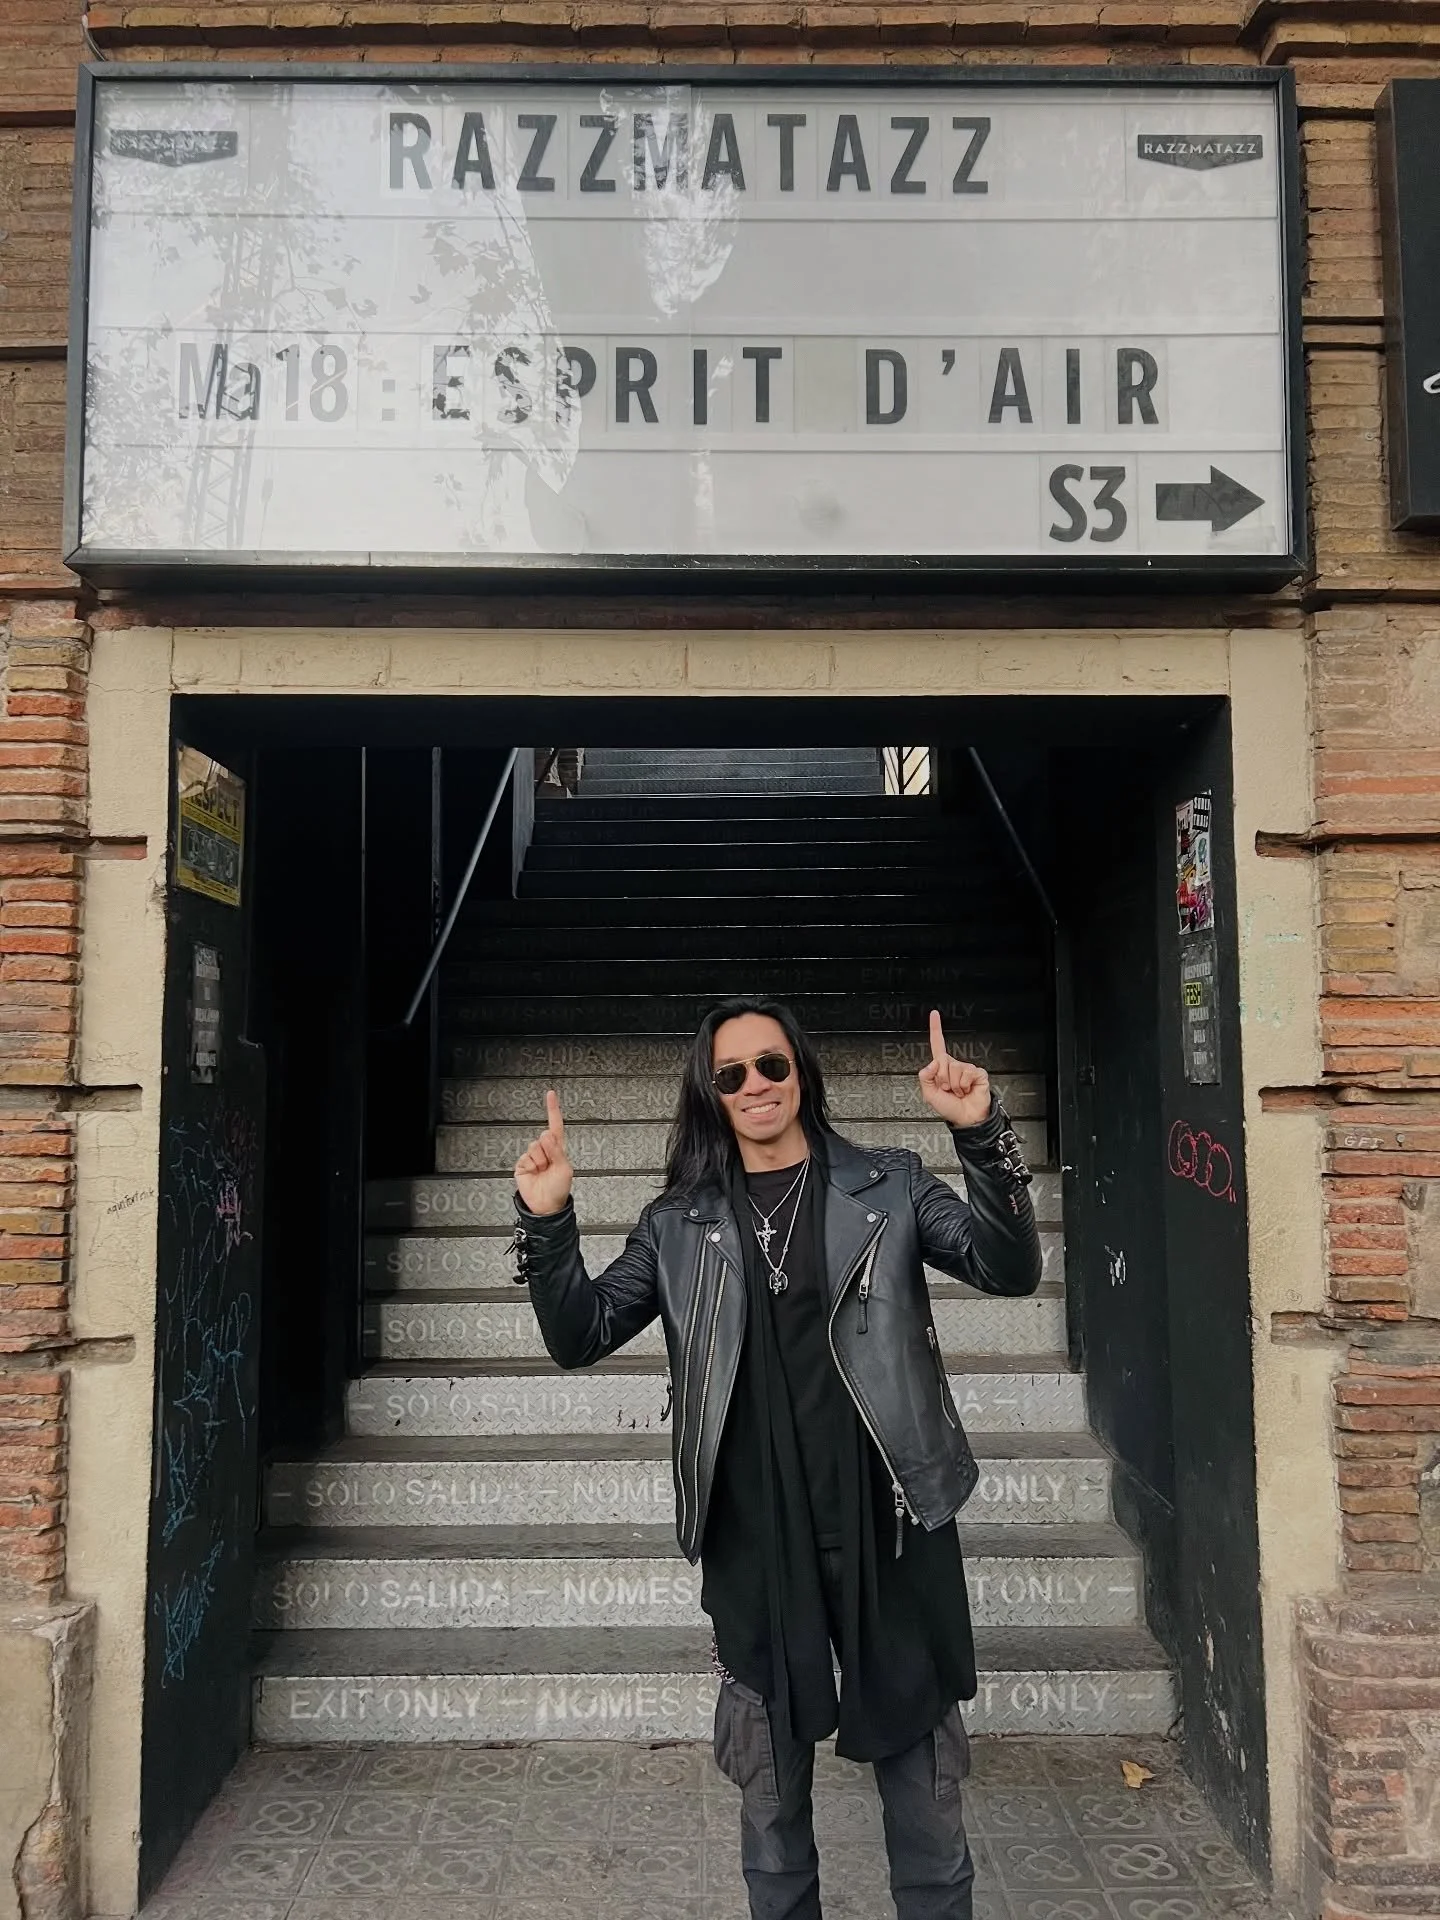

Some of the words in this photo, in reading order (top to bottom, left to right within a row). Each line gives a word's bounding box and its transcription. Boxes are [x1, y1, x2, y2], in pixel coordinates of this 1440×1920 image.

[389, 112, 991, 194] RAZZMATAZZ
[1143, 143, 1257, 154] RAZZMATAZZ
[432, 344, 782, 424] ESPRIT
[865, 347, 1159, 425] D'AIR
[1048, 464, 1128, 543] S3
[868, 1003, 915, 1020] EXIT
[901, 1133, 954, 1153] EXIT
[415, 1192, 487, 1214] SOLO
[386, 1251, 462, 1274] SOLO
[387, 1318, 467, 1343] SOLO
[386, 1393, 472, 1419] SOLO
[479, 1391, 594, 1417] SALIDA
[305, 1480, 396, 1507] SOLO
[405, 1478, 527, 1505] SALIDA
[979, 1473, 1068, 1504] ONLY
[379, 1577, 510, 1608] SALIDA
[563, 1576, 694, 1605] NOMES
[1000, 1574, 1098, 1604] ONLY
[289, 1688, 374, 1720] EXIT
[383, 1686, 483, 1719] ONLY
[534, 1686, 681, 1722] NOMES
[1010, 1682, 1113, 1713] ONLY
